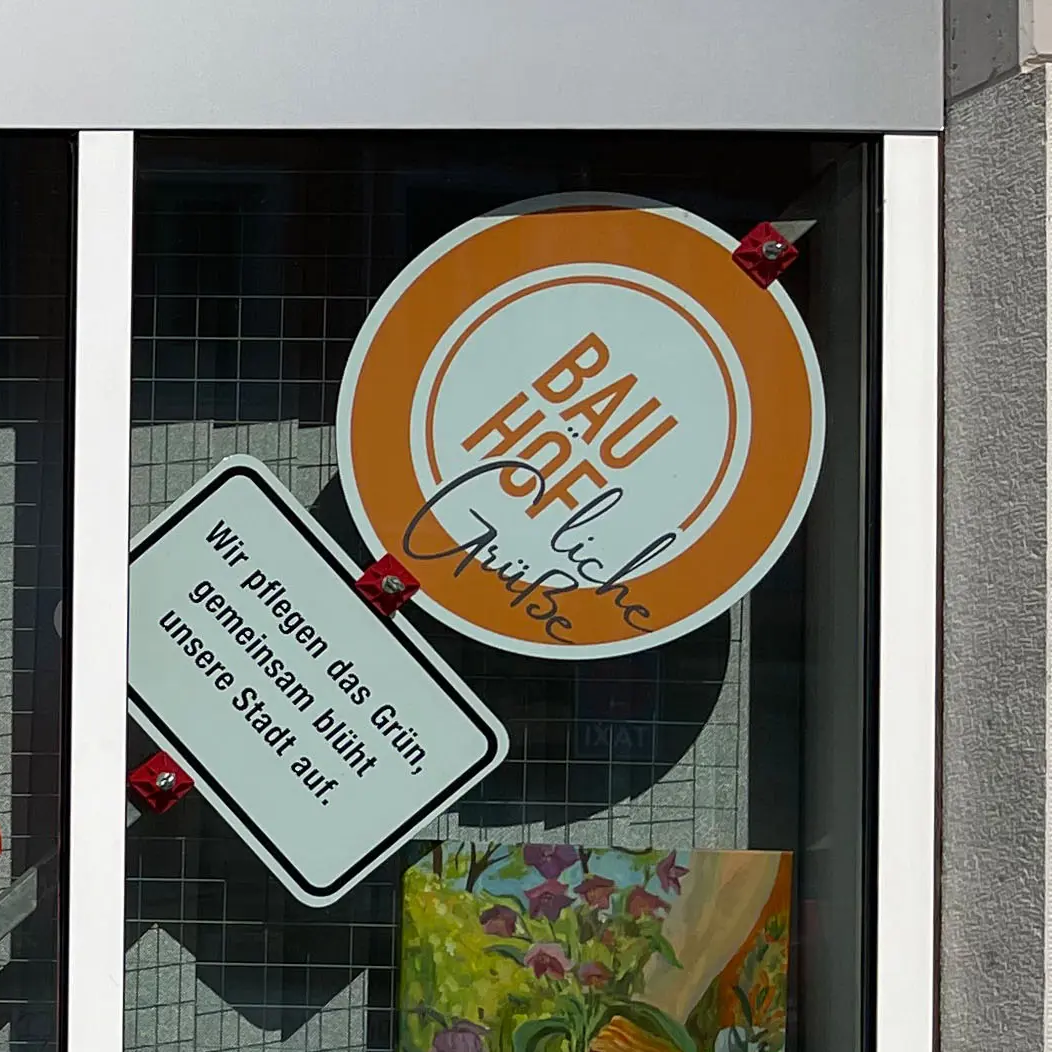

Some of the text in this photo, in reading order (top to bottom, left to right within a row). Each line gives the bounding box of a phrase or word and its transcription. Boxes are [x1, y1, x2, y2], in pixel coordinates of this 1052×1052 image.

[532, 332, 678, 469] BAU
[205, 519, 427, 775] Wir pflegen das Grün,
[403, 460, 578, 645] Grüße
[159, 609, 340, 805] unsere Stadt auf.
[188, 580, 378, 777] gemeinsam blüht
